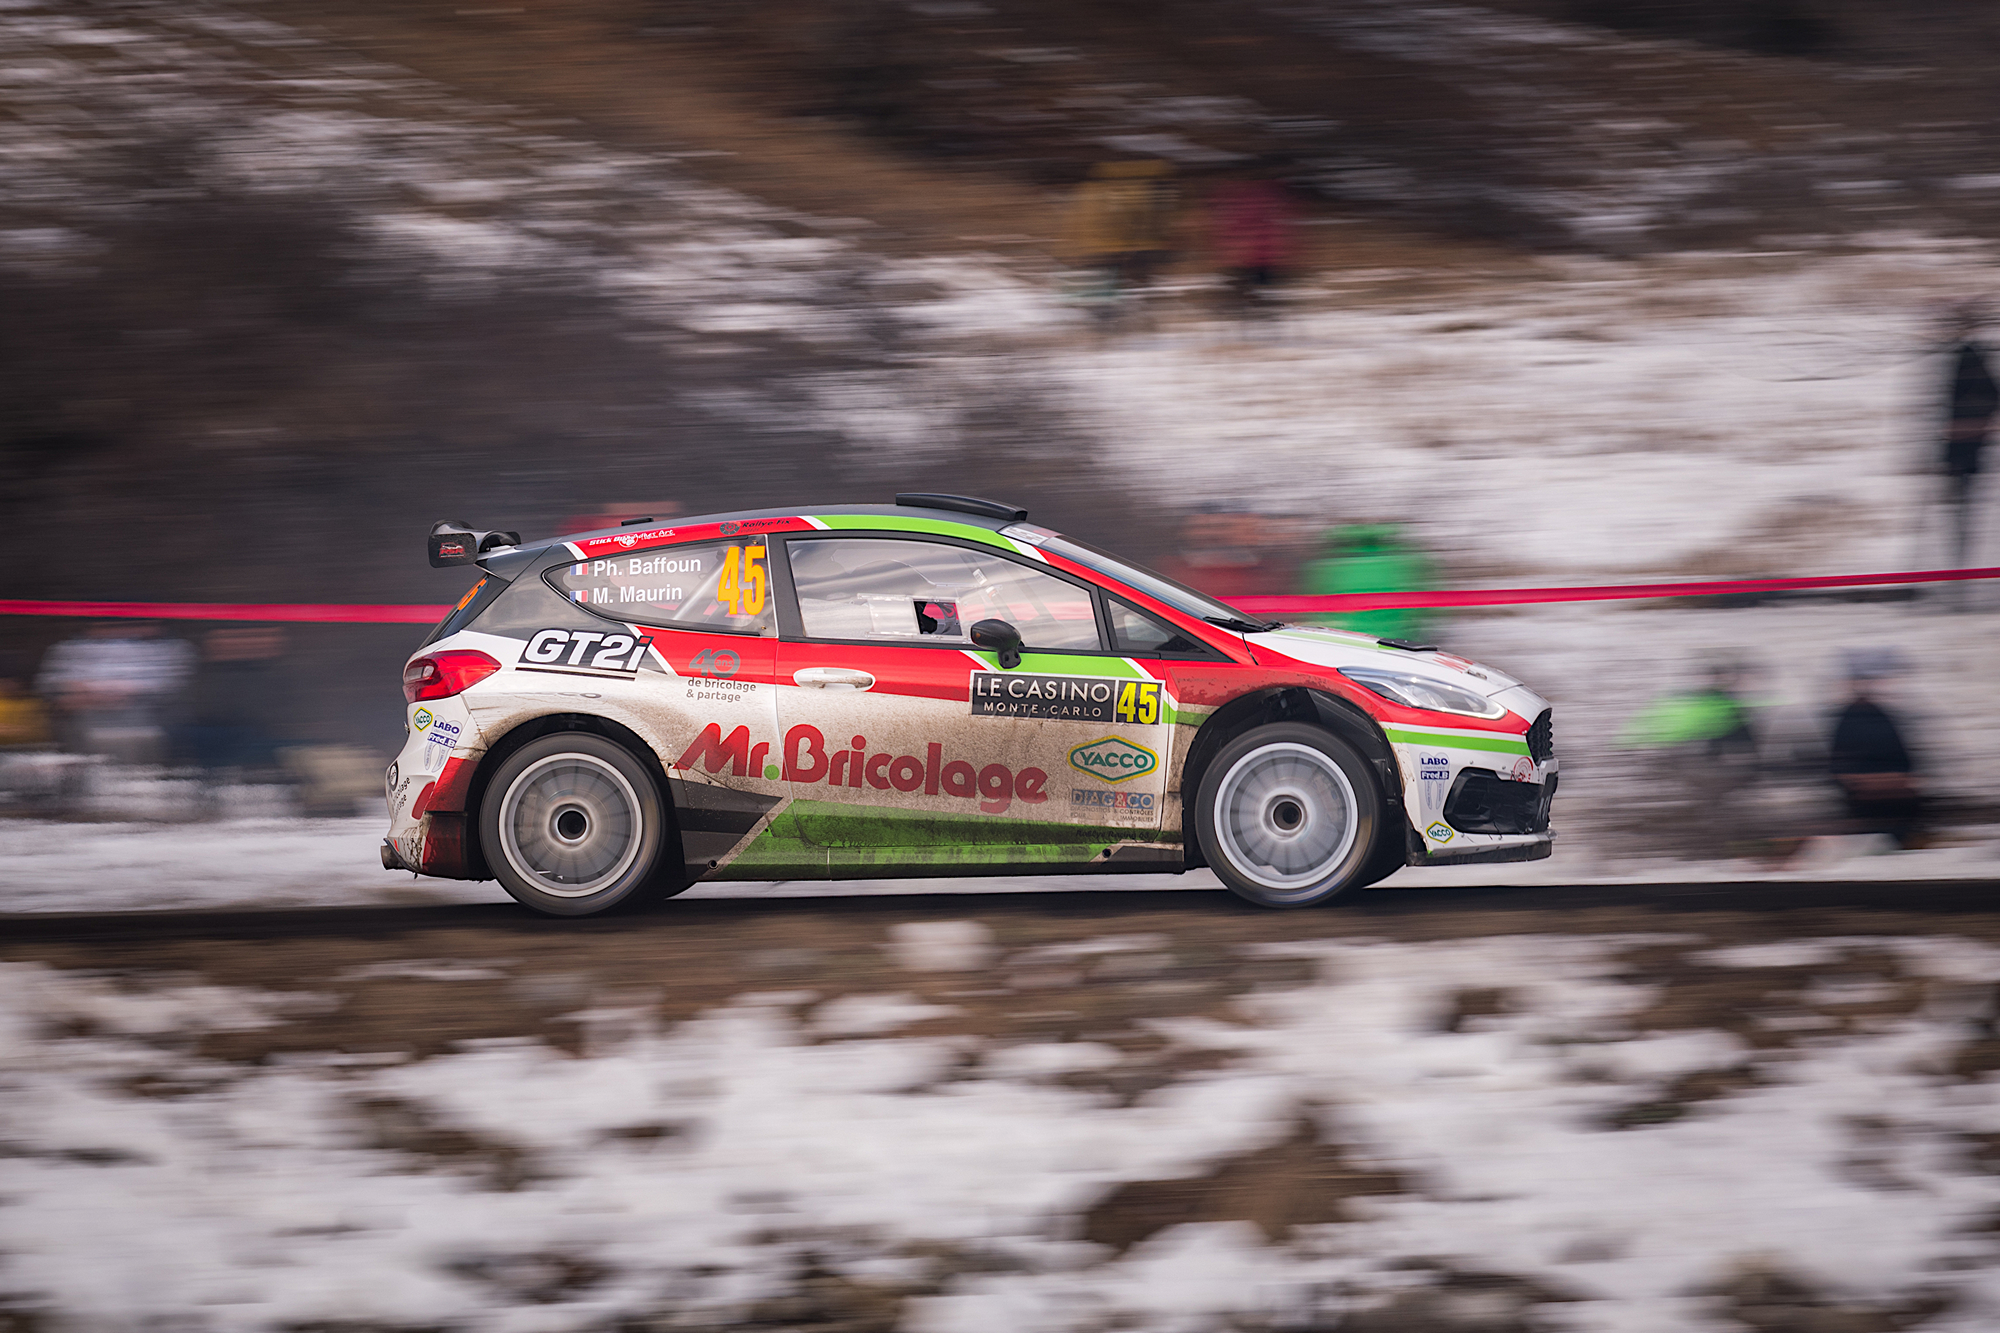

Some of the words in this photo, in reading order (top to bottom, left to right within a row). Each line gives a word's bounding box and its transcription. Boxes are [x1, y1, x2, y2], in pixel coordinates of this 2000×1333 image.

[593, 561, 622, 577] Ph.
[629, 558, 701, 576] Baffoun
[717, 545, 766, 616] 45
[593, 588, 613, 604] M.
[620, 584, 682, 603] Maurin
[524, 629, 652, 671] GT2i
[688, 648, 741, 678] 40
[715, 659, 733, 667] ans
[688, 676, 701, 687] de
[705, 678, 756, 692] bricolage
[977, 677, 1003, 697] LE
[1008, 679, 1111, 703] CASINO
[686, 689, 694, 698] &
[697, 691, 741, 703] partage
[1117, 682, 1158, 724] 45
[434, 720, 460, 734] LABO
[1080, 751, 1148, 769] YACCO
[1421, 758, 1448, 766] LABO
[1422, 771, 1448, 779] Fred.B
[1072, 790, 1154, 809] DIAG&CO
[1430, 829, 1451, 837] YACCO
